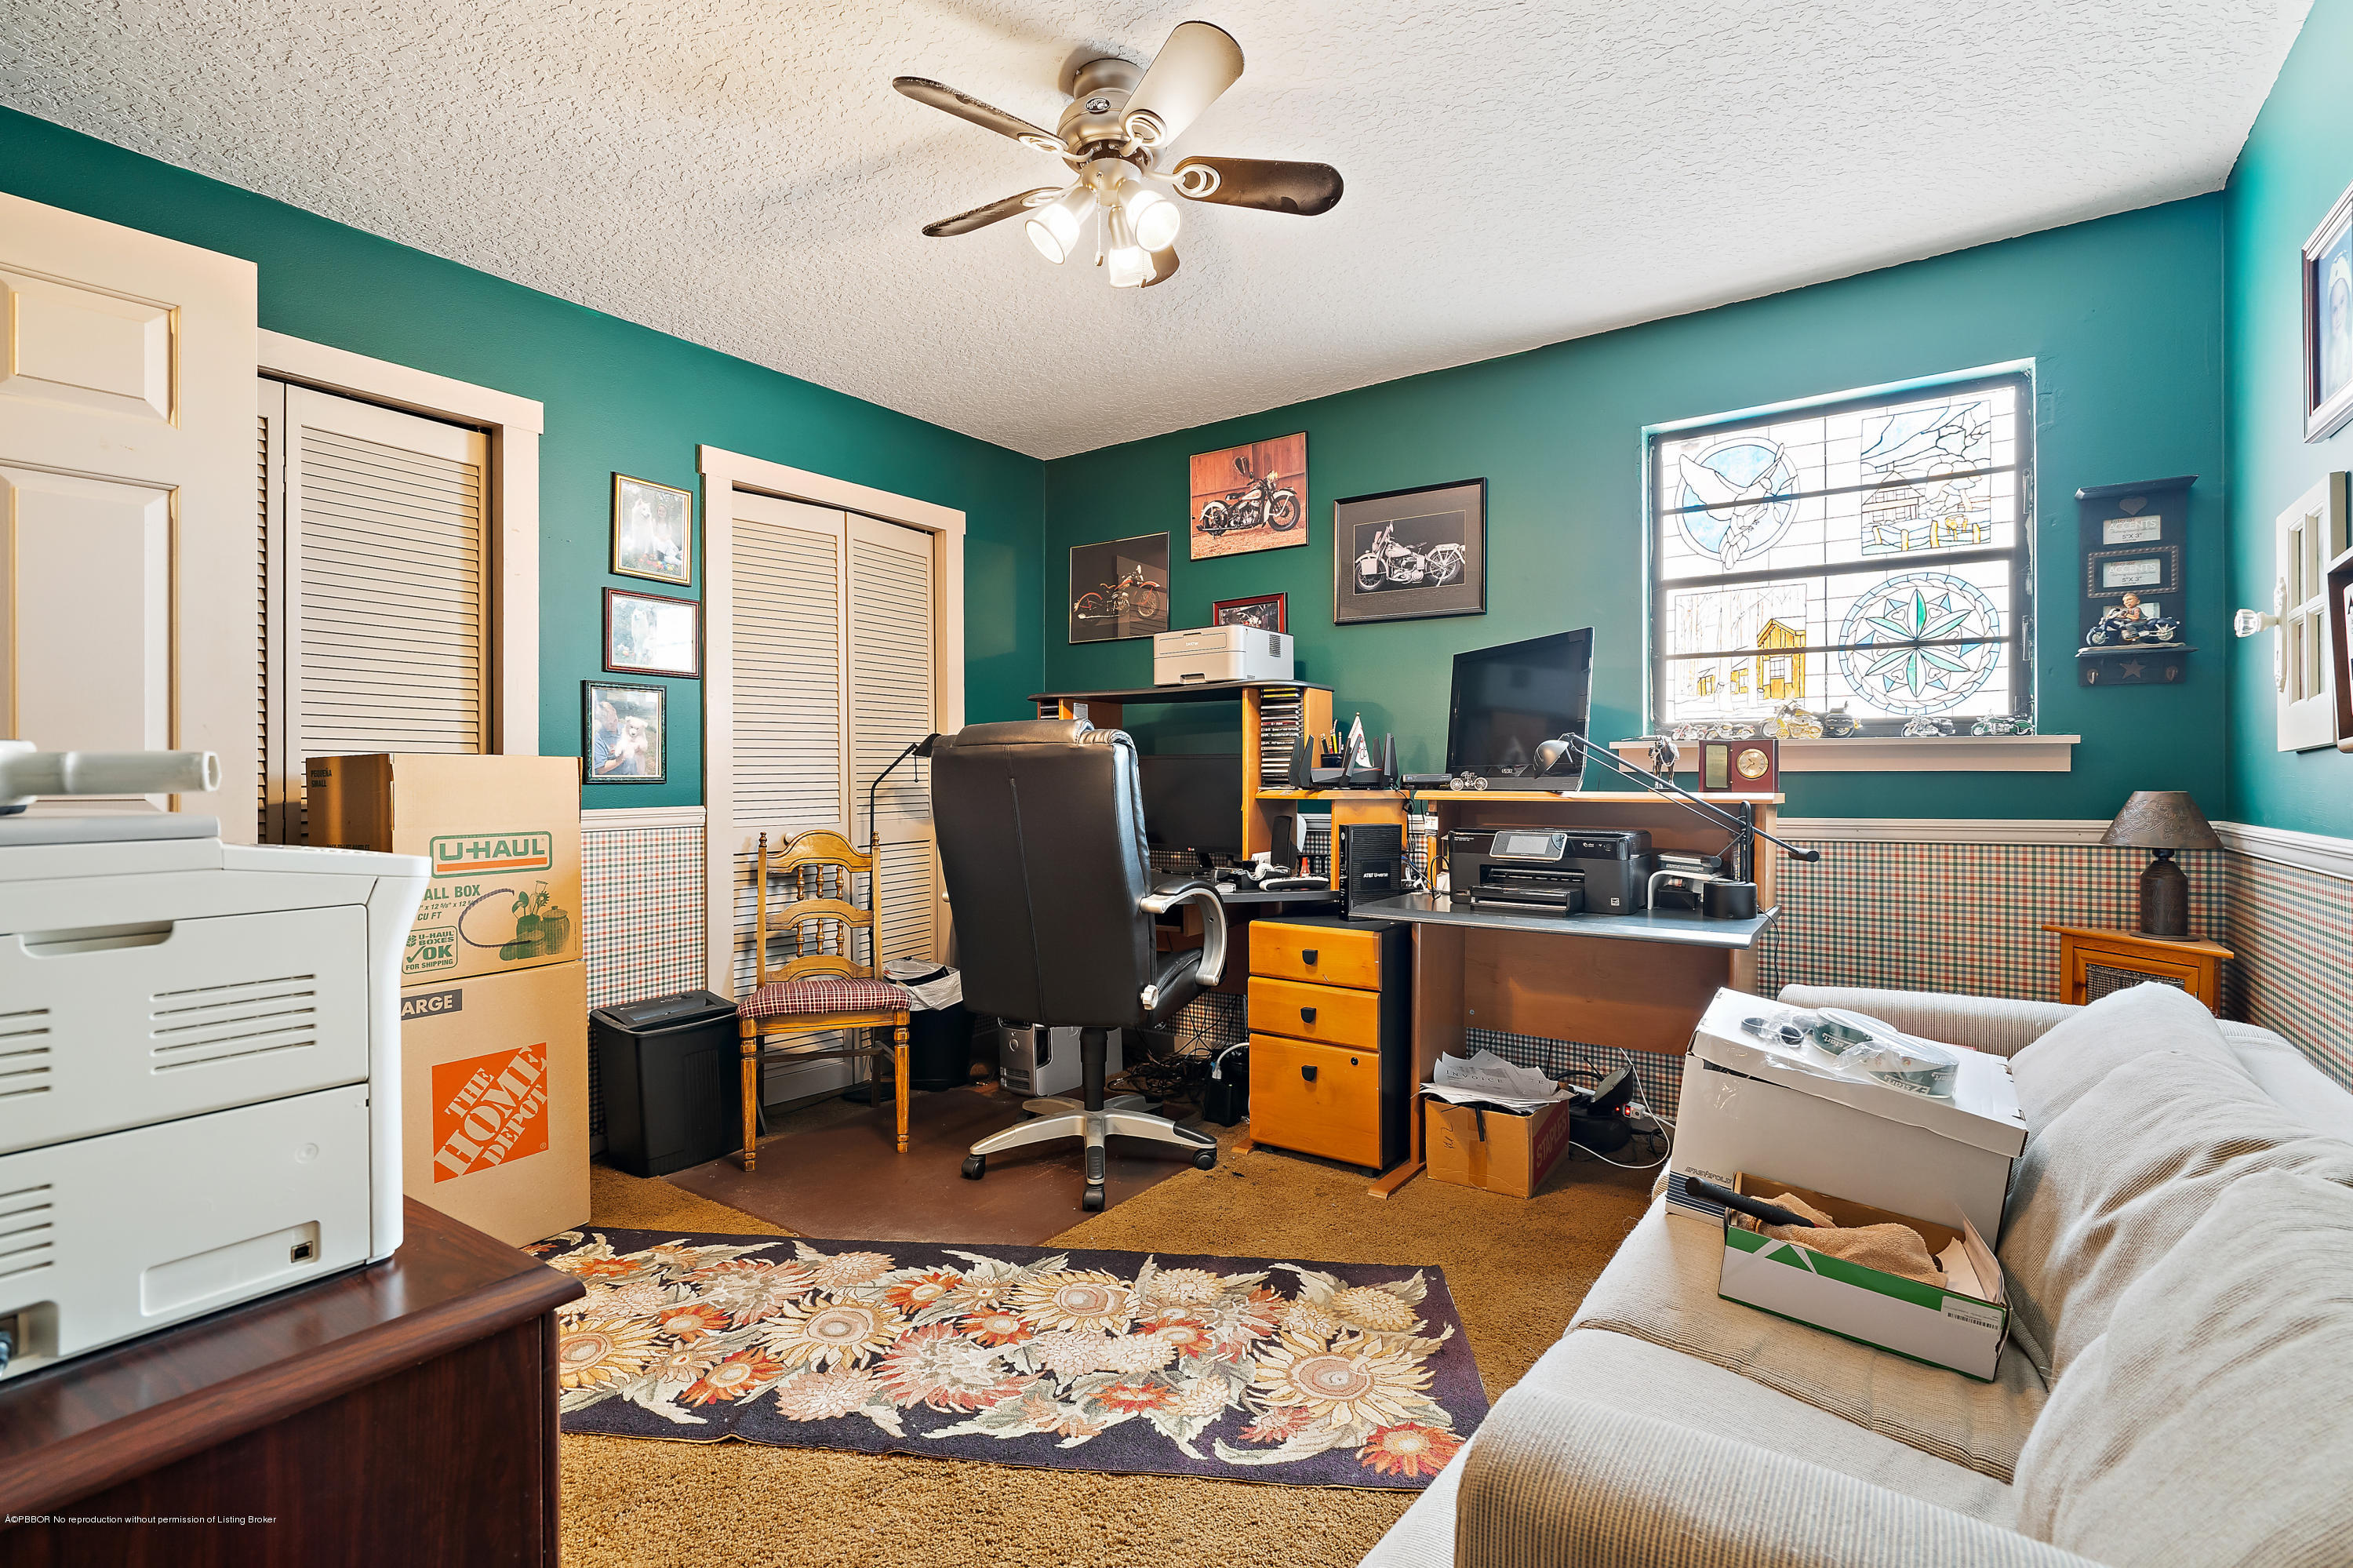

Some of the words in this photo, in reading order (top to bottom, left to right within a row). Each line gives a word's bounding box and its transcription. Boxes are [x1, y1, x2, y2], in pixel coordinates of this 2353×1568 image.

[2108, 520, 2157, 531] ACCENTS
[2108, 563, 2156, 573] ACCENTS
[439, 838, 545, 861] U-HAUL
[424, 887, 449, 901] ALL
[455, 884, 481, 898] BOX
[418, 931, 454, 940] U-HAUL
[418, 937, 454, 946] BOXES
[423, 944, 453, 960] OK
[421, 959, 453, 969] SHIPPING
[401, 995, 453, 1017] ARGE
[1446, 1069, 1504, 1083] INVOICE
[444, 1067, 495, 1119] THE
[434, 1046, 547, 1177] HOME
[482, 1084, 547, 1166] DEPOT
[1537, 1111, 1567, 1168] STAPLES
